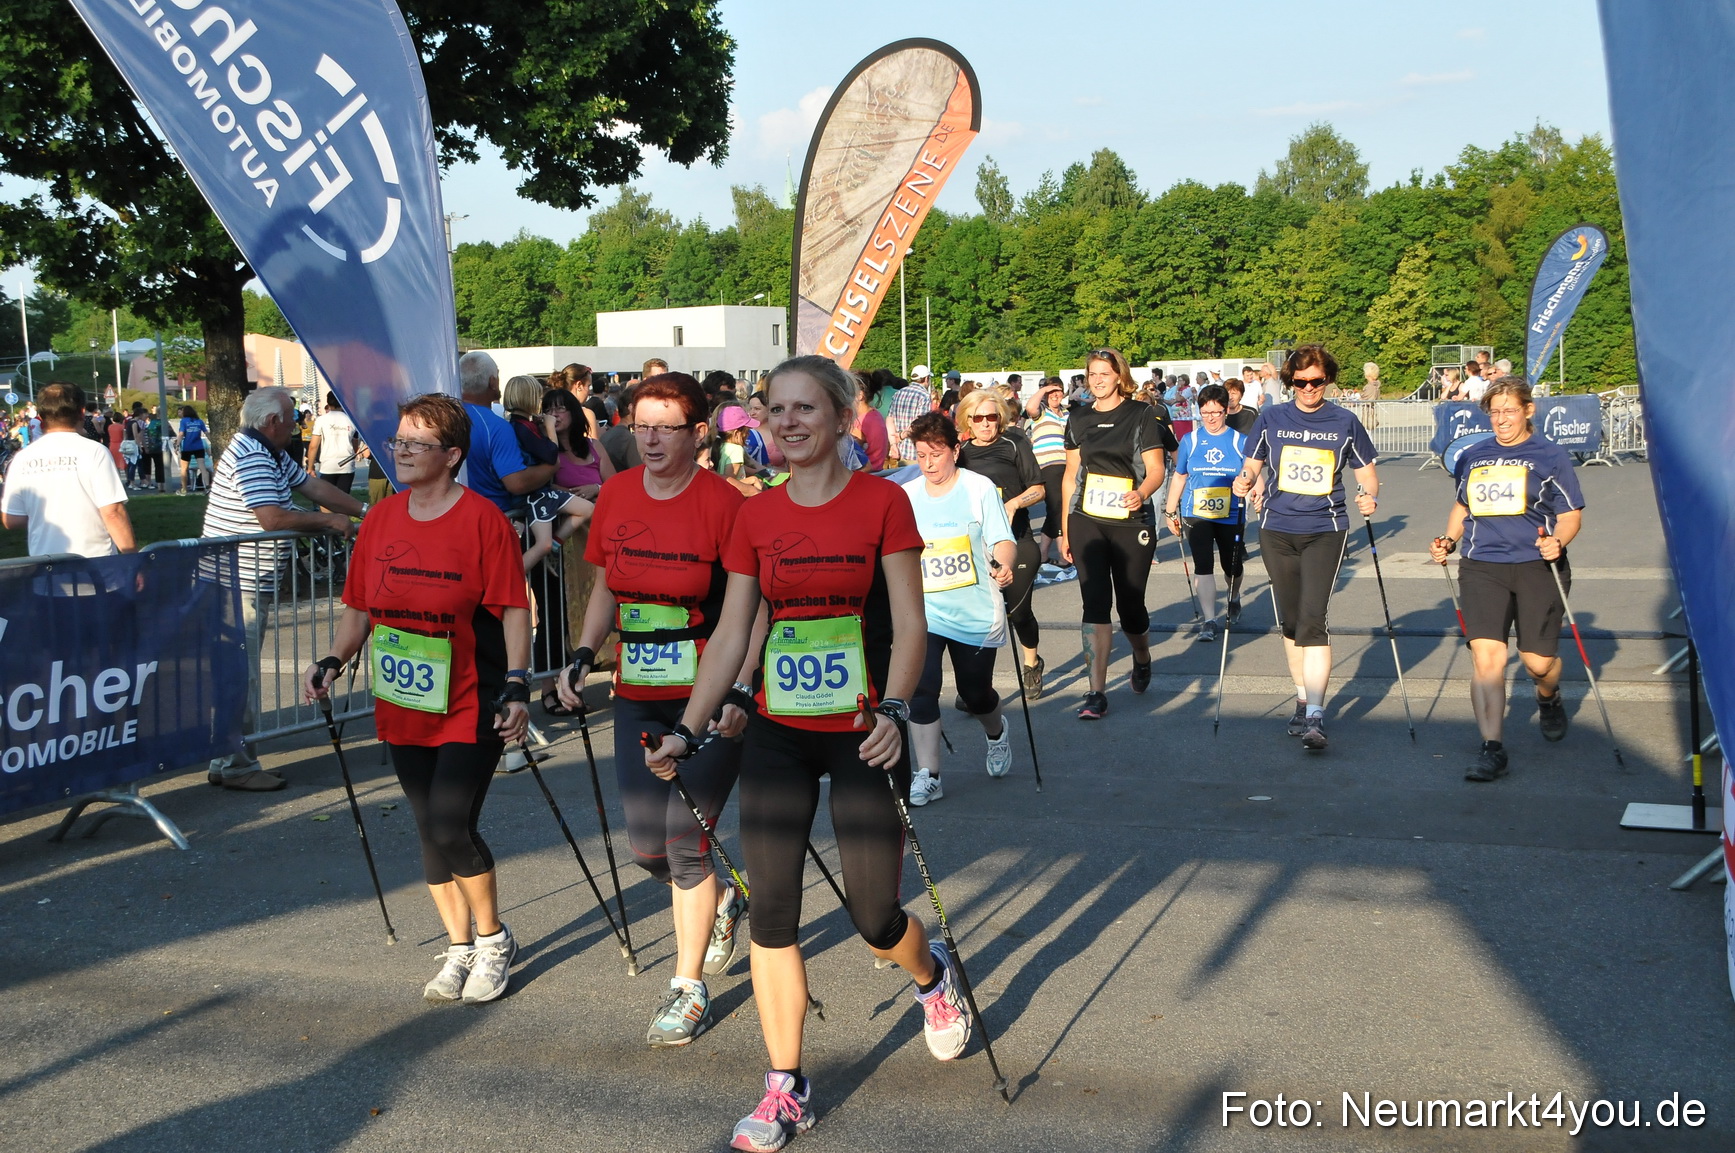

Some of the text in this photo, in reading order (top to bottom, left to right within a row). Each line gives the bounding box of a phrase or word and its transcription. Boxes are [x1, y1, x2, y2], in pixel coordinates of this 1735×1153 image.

[1531, 260, 1583, 334] Frischmann
[1553, 419, 1591, 437] Fischer
[1556, 437, 1587, 446] AUTOMOBILE
[1287, 463, 1324, 483] 363
[1476, 482, 1515, 502] 364
[1199, 498, 1225, 512] 293
[621, 547, 700, 562] Physiotherapie Wild
[779, 554, 866, 567] Physiotherapie Wild
[388, 565, 463, 582] Physiotherapie Wild
[920, 553, 971, 578] 1388
[785, 595, 826, 608] machen
[384, 608, 422, 620] machen
[423, 610, 438, 623] Sie
[626, 640, 682, 666] 994
[380, 654, 435, 693] 993
[776, 652, 849, 692] 995
